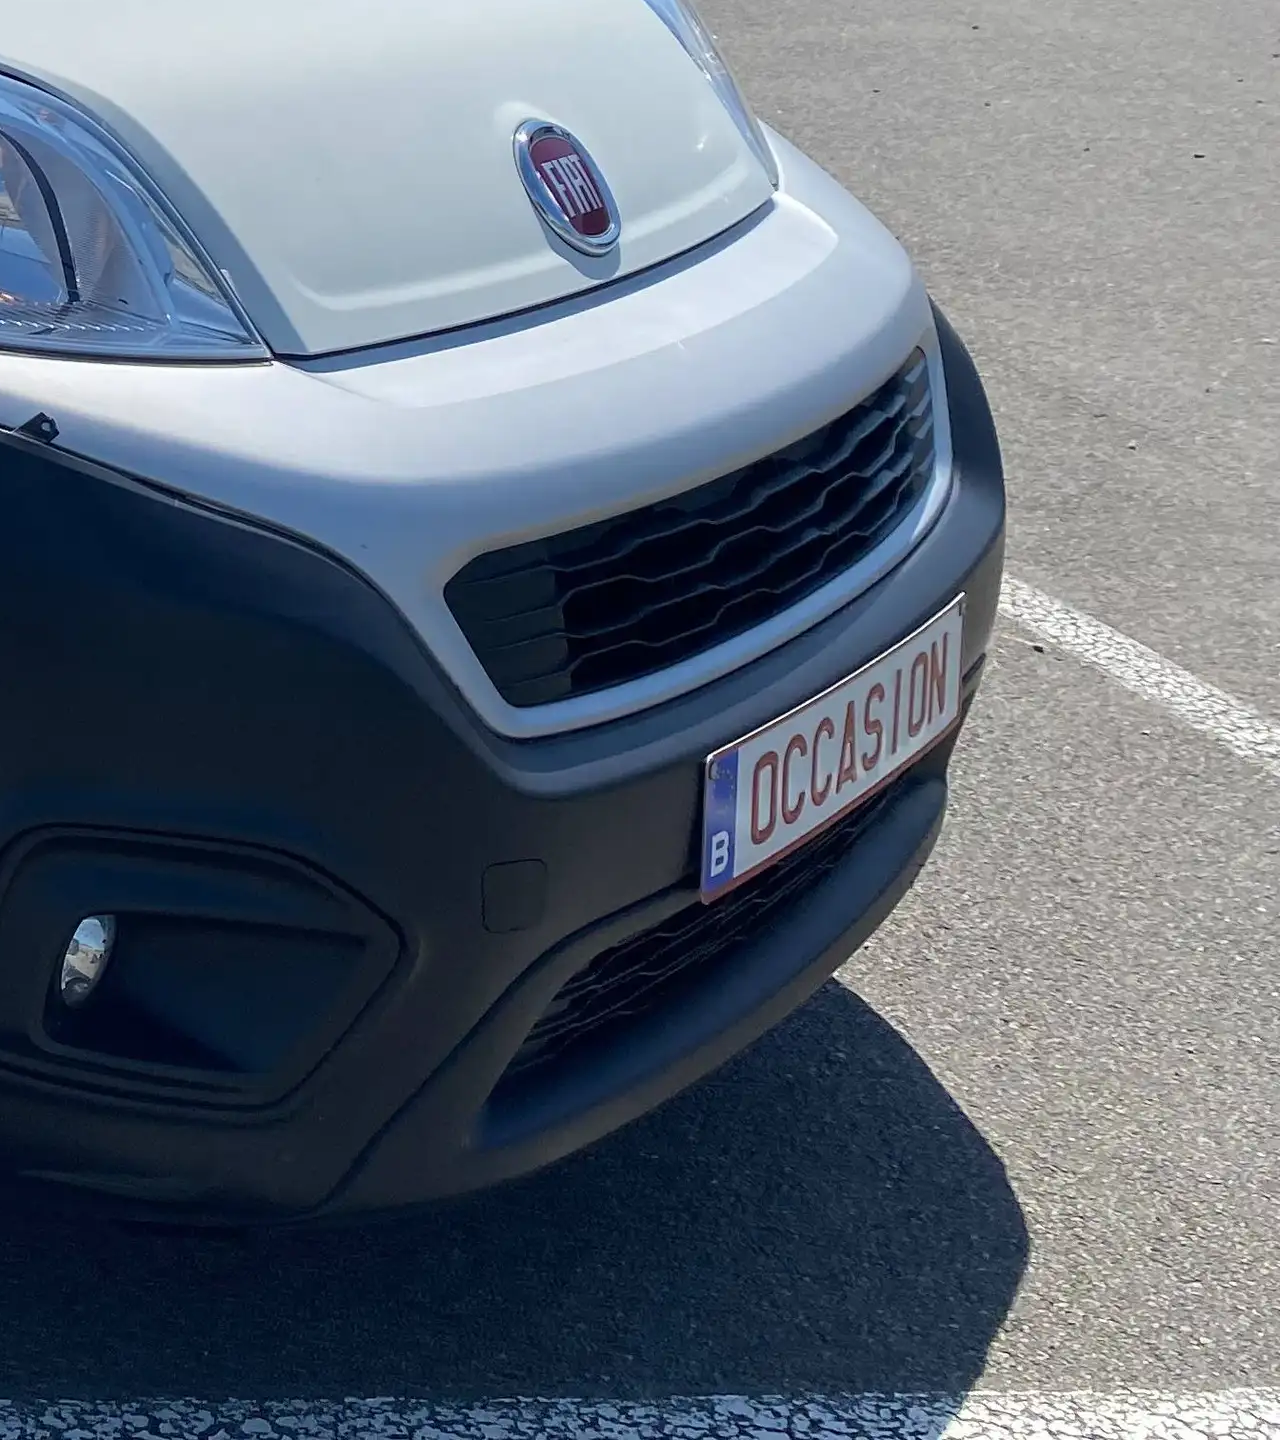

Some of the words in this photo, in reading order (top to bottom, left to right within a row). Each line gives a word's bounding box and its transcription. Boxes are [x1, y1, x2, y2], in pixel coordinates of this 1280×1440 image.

[541, 154, 604, 218] FIAT
[750, 631, 949, 846] OCCASION
[710, 830, 730, 878] B
